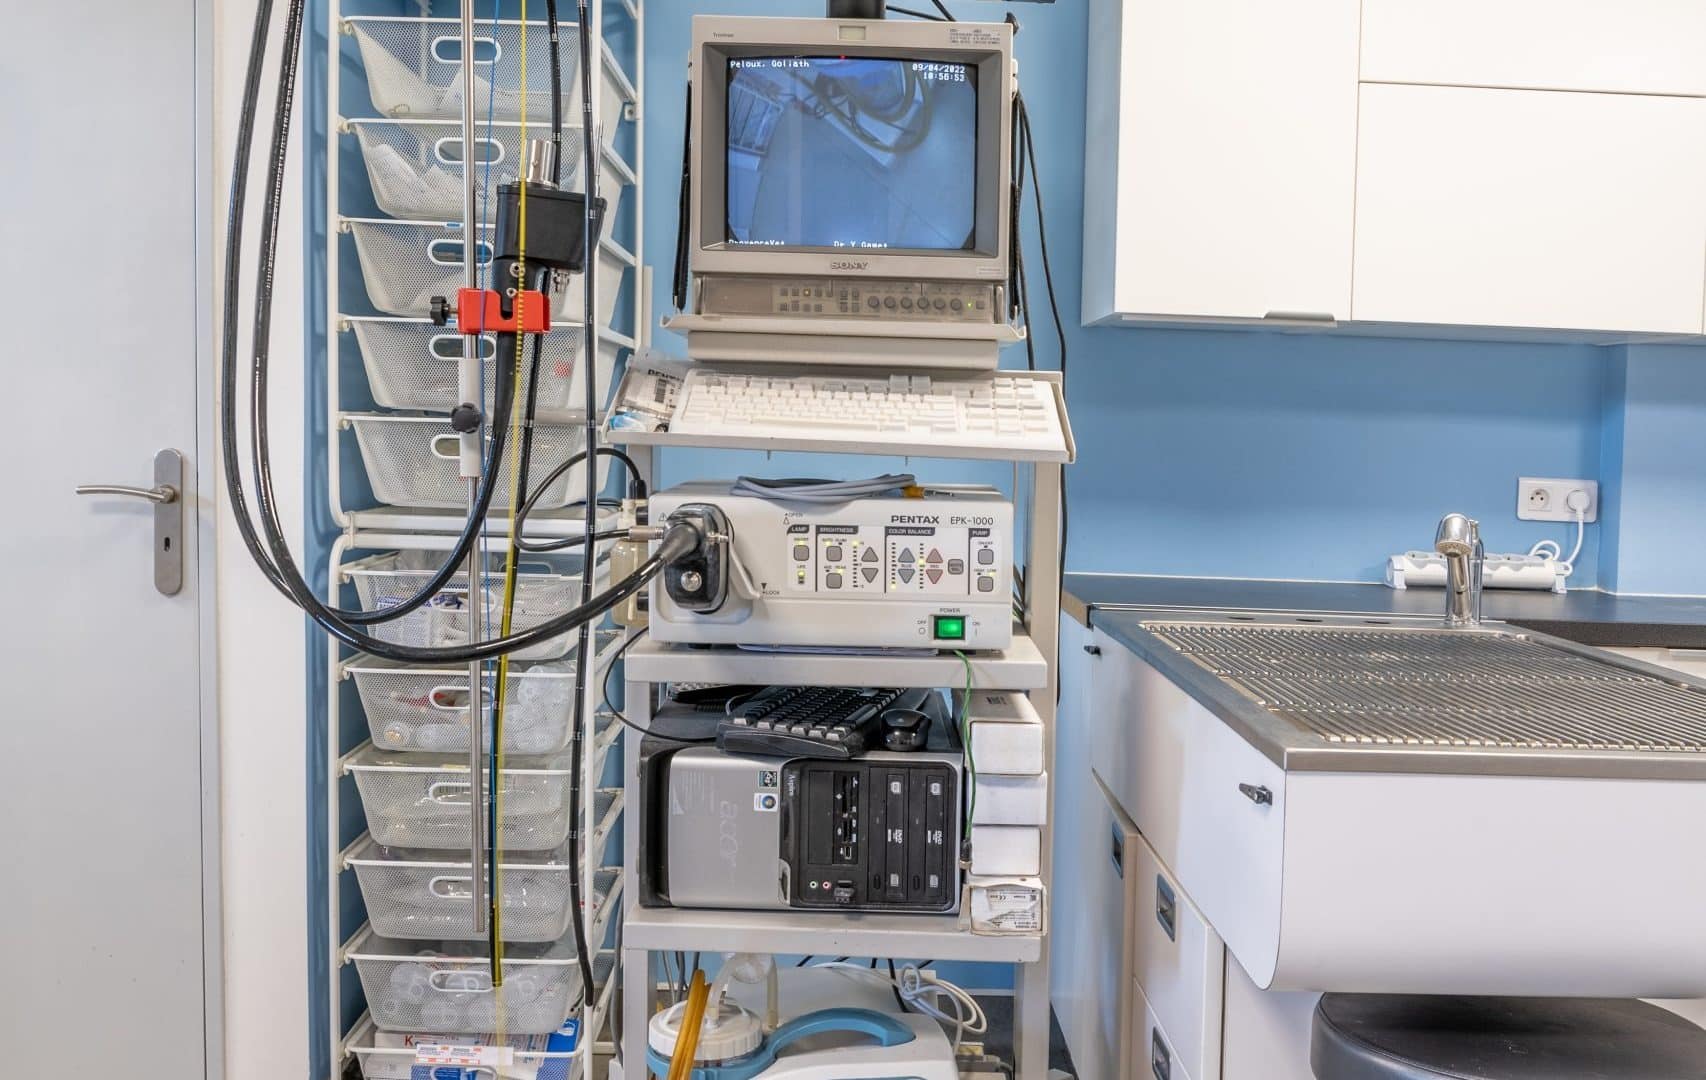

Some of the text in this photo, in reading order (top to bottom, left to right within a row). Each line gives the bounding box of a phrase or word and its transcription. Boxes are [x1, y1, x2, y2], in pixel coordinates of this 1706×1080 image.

[831, 261, 869, 270] SONY
[891, 515, 994, 525] PENTAX EPK-1000
